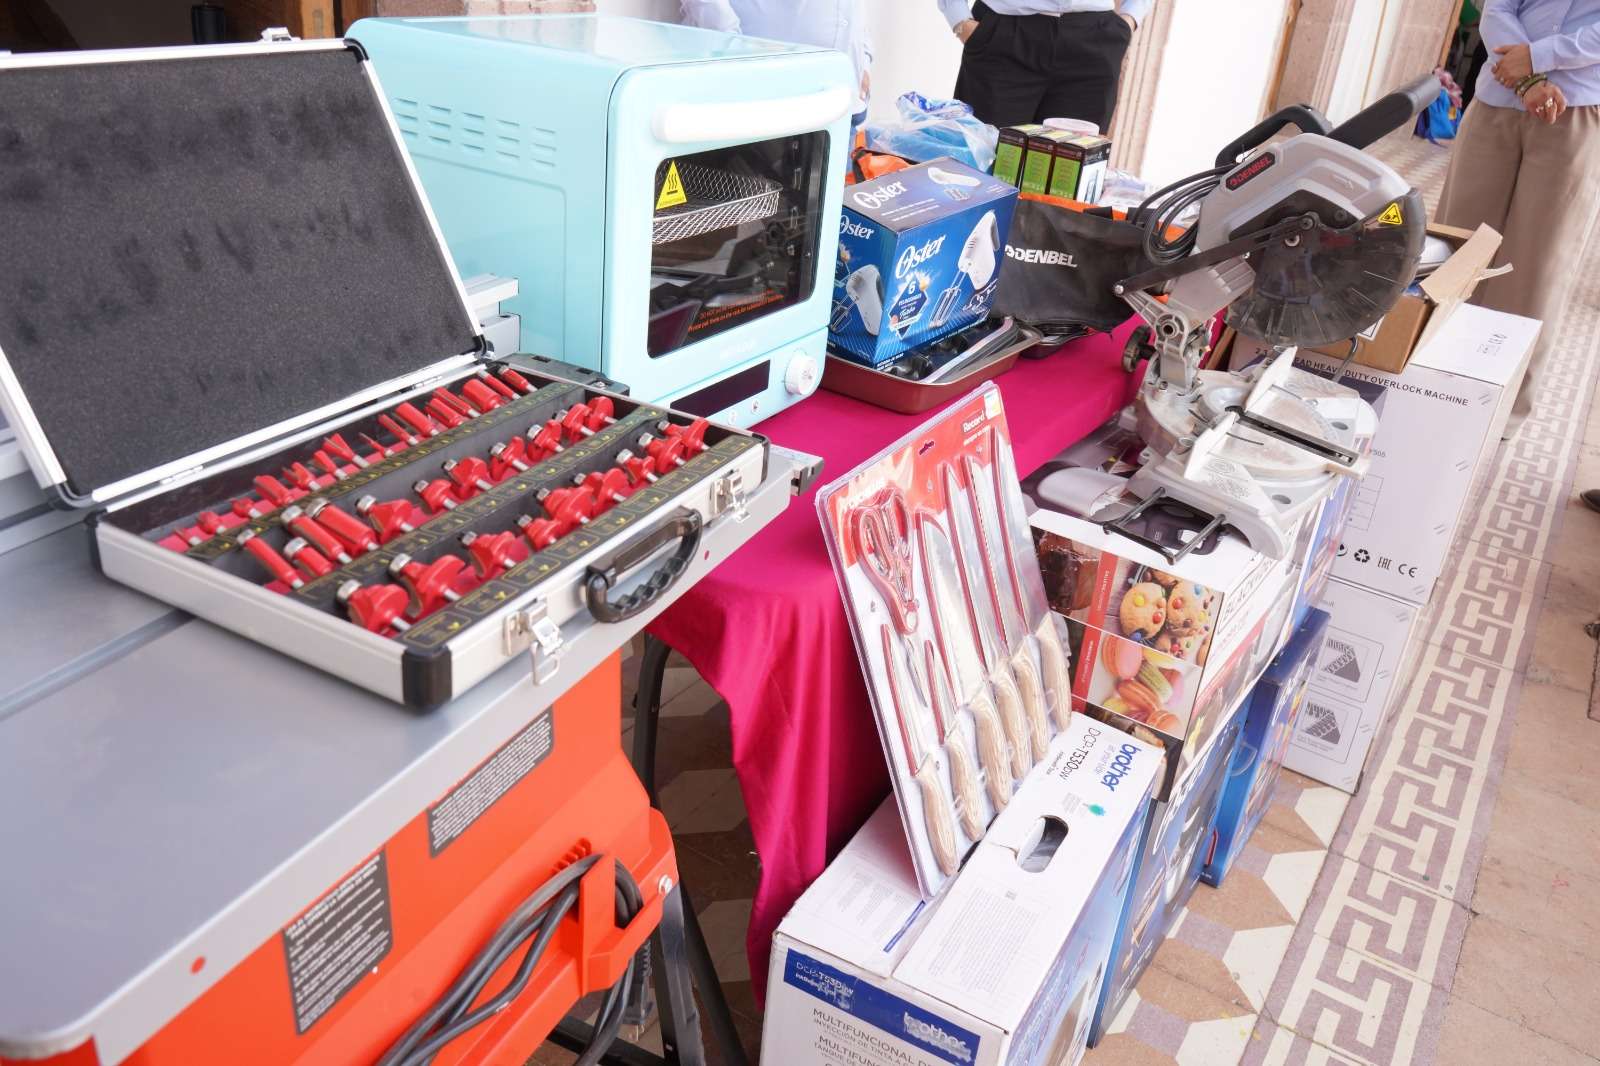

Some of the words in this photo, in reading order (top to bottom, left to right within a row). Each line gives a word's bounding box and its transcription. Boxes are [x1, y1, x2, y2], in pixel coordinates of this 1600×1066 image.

[853, 180, 908, 209] Oster
[895, 235, 947, 279] Oster
[908, 280, 916, 294] 6
[1313, 360, 1339, 374] HEAV
[1345, 370, 1370, 383] DUTY
[1370, 376, 1422, 396] OVERLOCK
[1424, 389, 1469, 407] MACHINE
[1100, 743, 1142, 792] brother
[813, 1008, 914, 1064] MULTIFUNCIONAL
